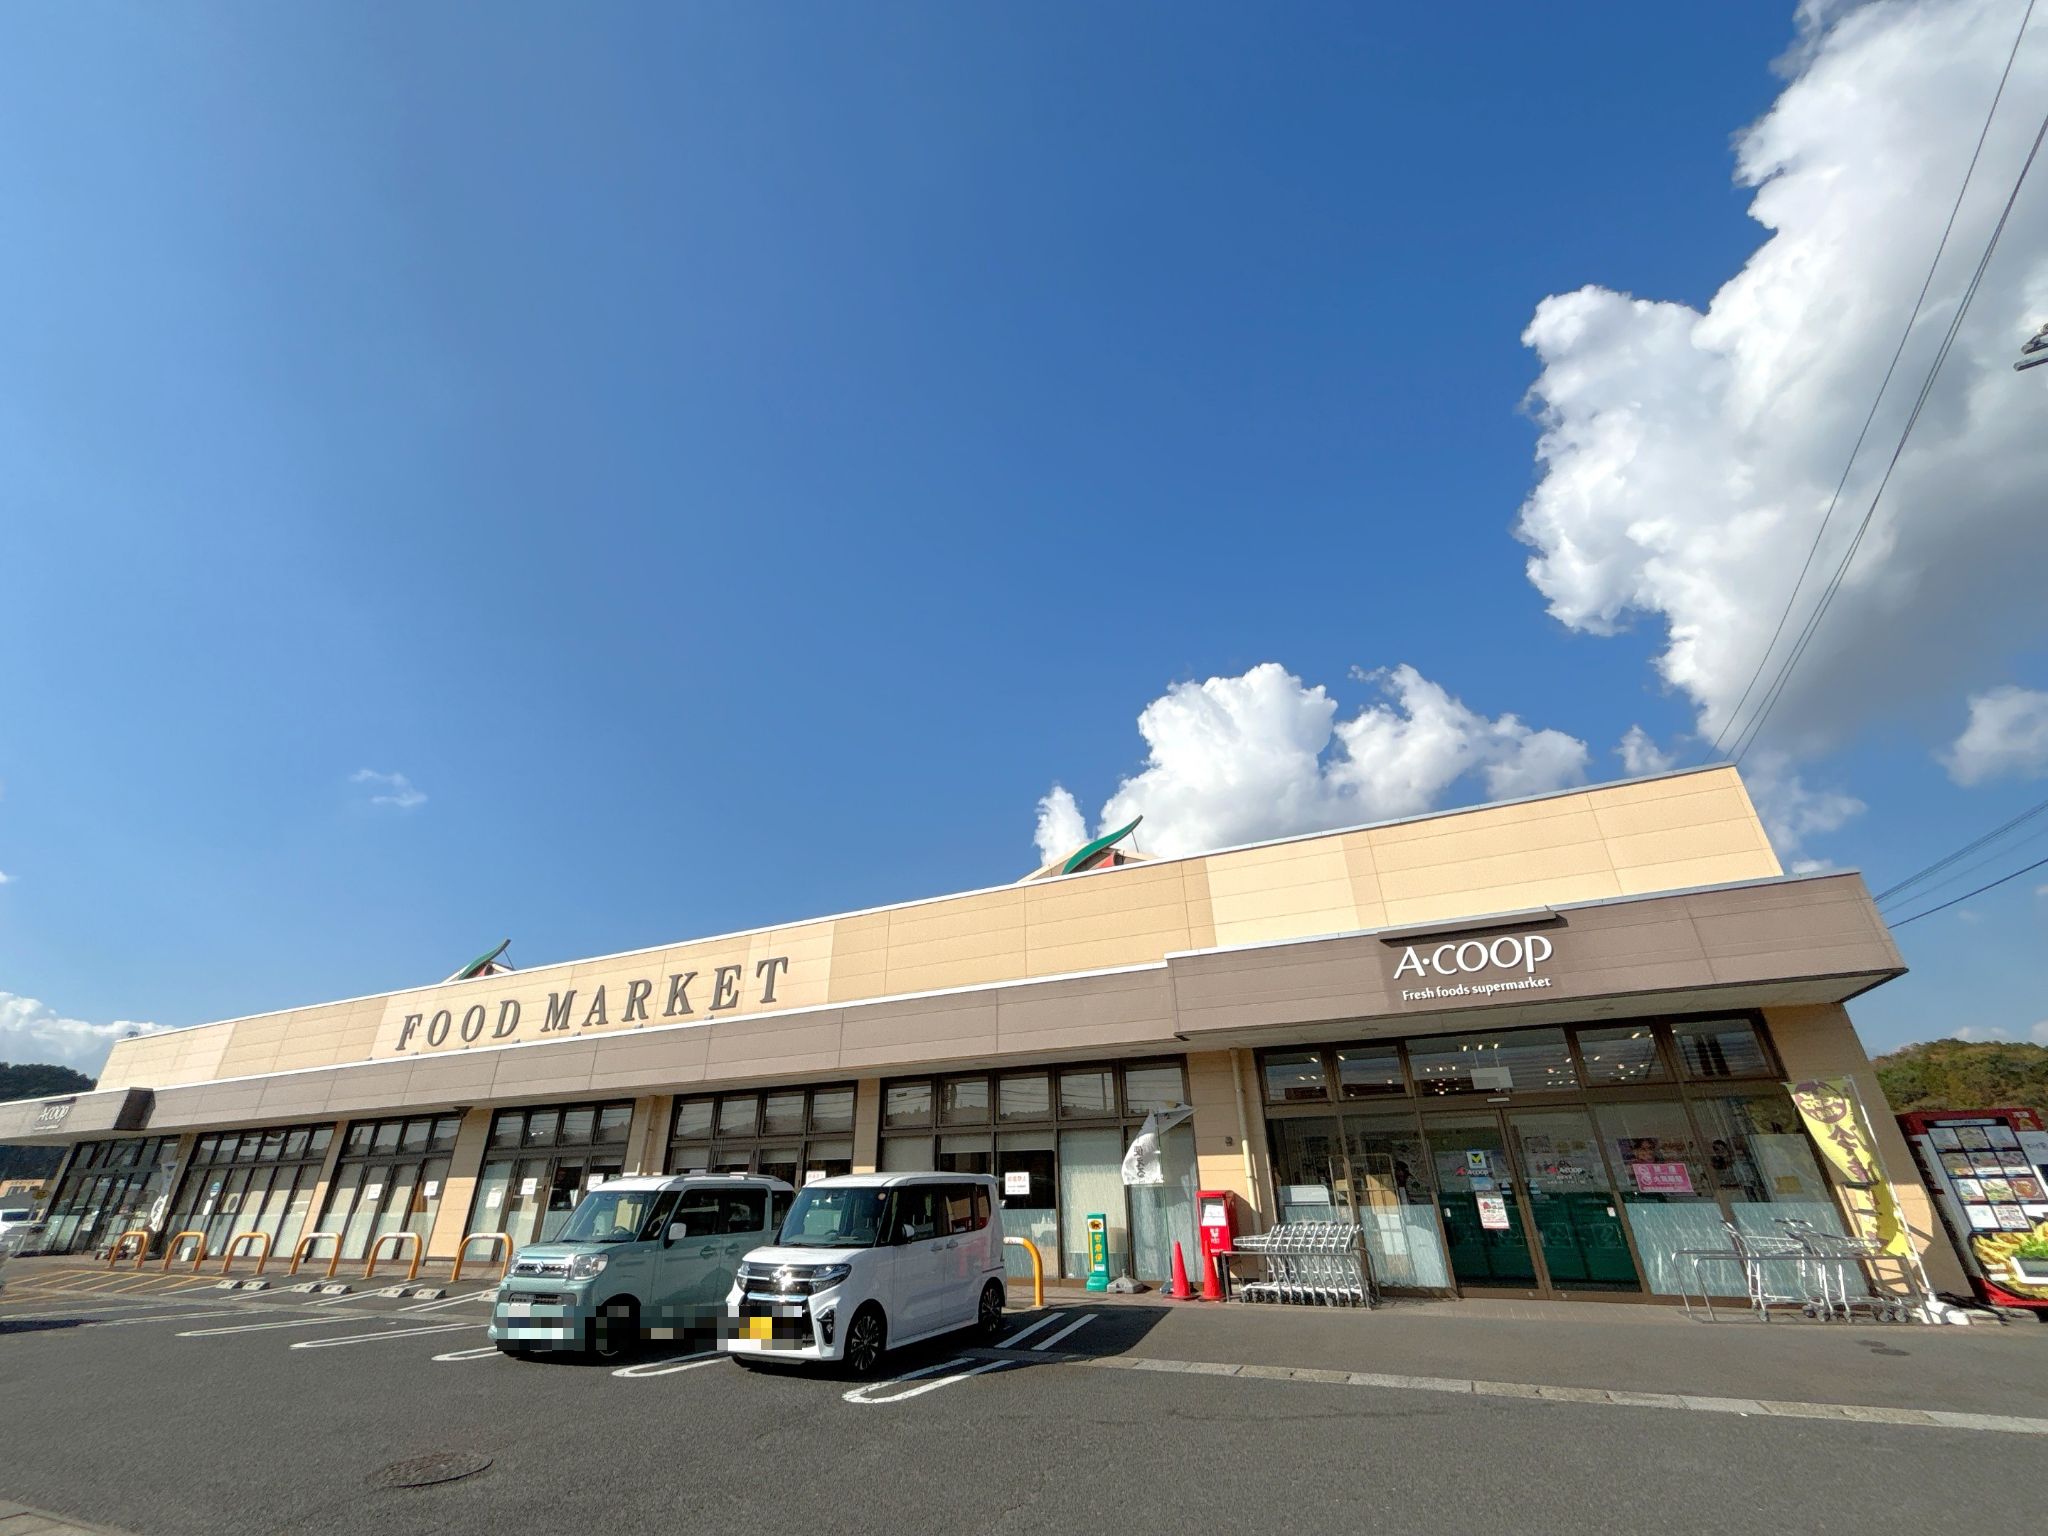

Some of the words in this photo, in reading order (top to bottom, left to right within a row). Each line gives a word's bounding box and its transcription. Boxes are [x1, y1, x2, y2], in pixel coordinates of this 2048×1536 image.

[395, 998, 521, 1051] FOOD
[540, 956, 789, 1033] MARKET
[1402, 987, 1435, 1001] Fresh
[1436, 982, 1470, 997] foods
[1472, 976, 1552, 997] supermarket
